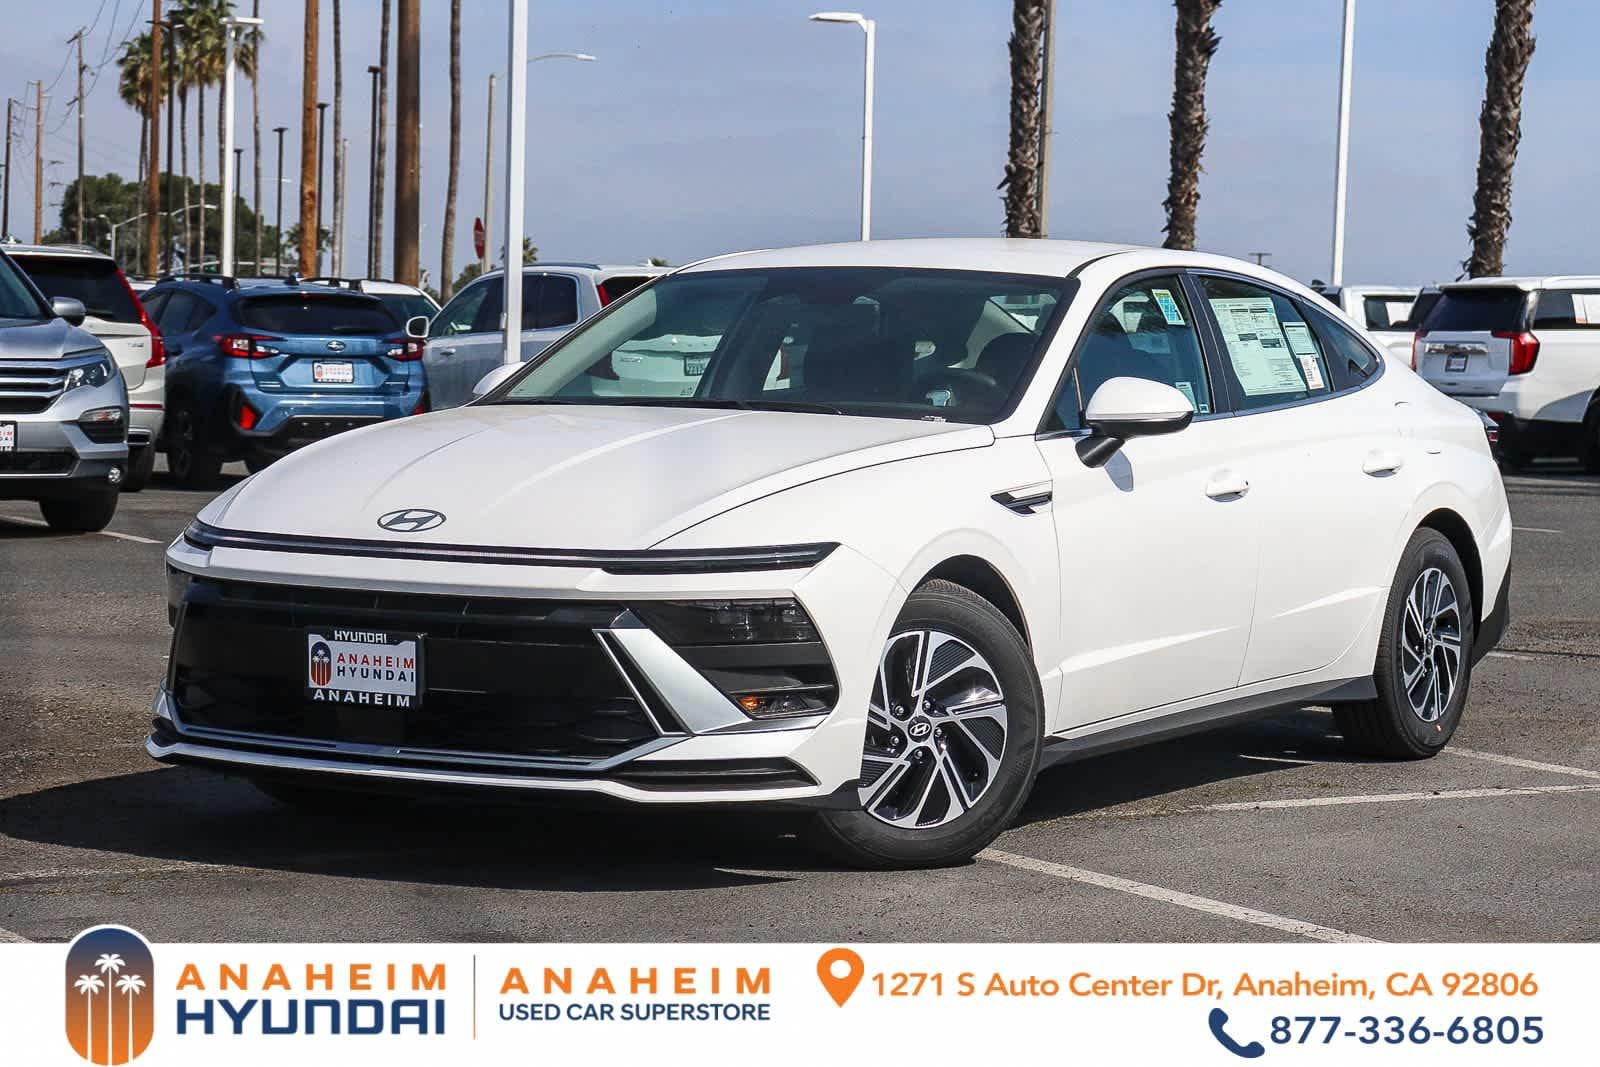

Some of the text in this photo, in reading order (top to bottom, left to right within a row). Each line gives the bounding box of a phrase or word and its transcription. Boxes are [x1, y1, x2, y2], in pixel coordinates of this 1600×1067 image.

[334, 630, 387, 644] HYUNDAI
[337, 652, 414, 669] ANAHEIM
[337, 666, 414, 682] HYUNDAI
[313, 689, 410, 707] ANAHEIM
